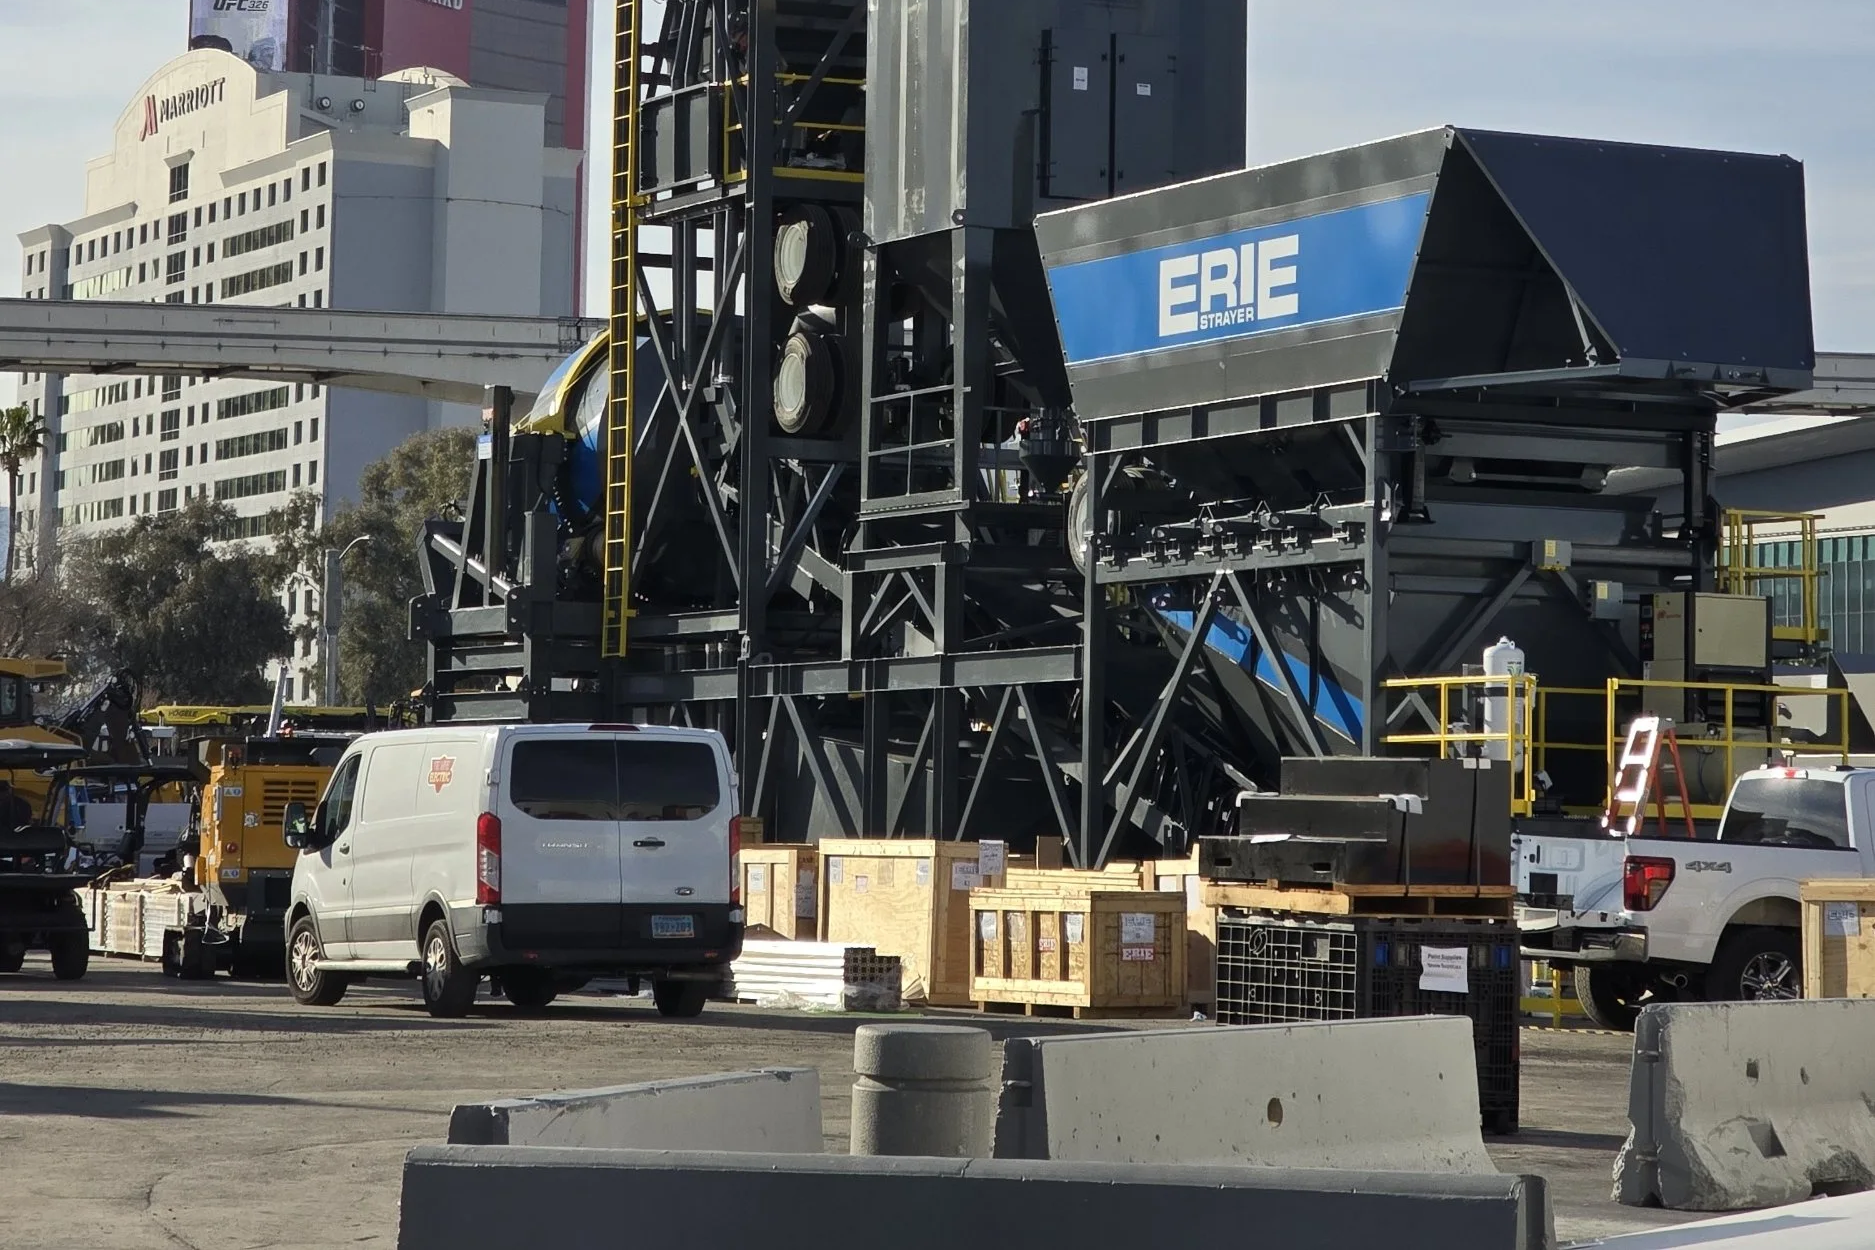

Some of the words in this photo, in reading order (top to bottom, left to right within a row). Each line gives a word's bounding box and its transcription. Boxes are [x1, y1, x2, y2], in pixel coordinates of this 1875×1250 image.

[247, 0, 269, 11] 326
[160, 77, 226, 123] MARRIOTT
[1159, 234, 1299, 337] ERIE
[1200, 306, 1254, 330] STRAYER
